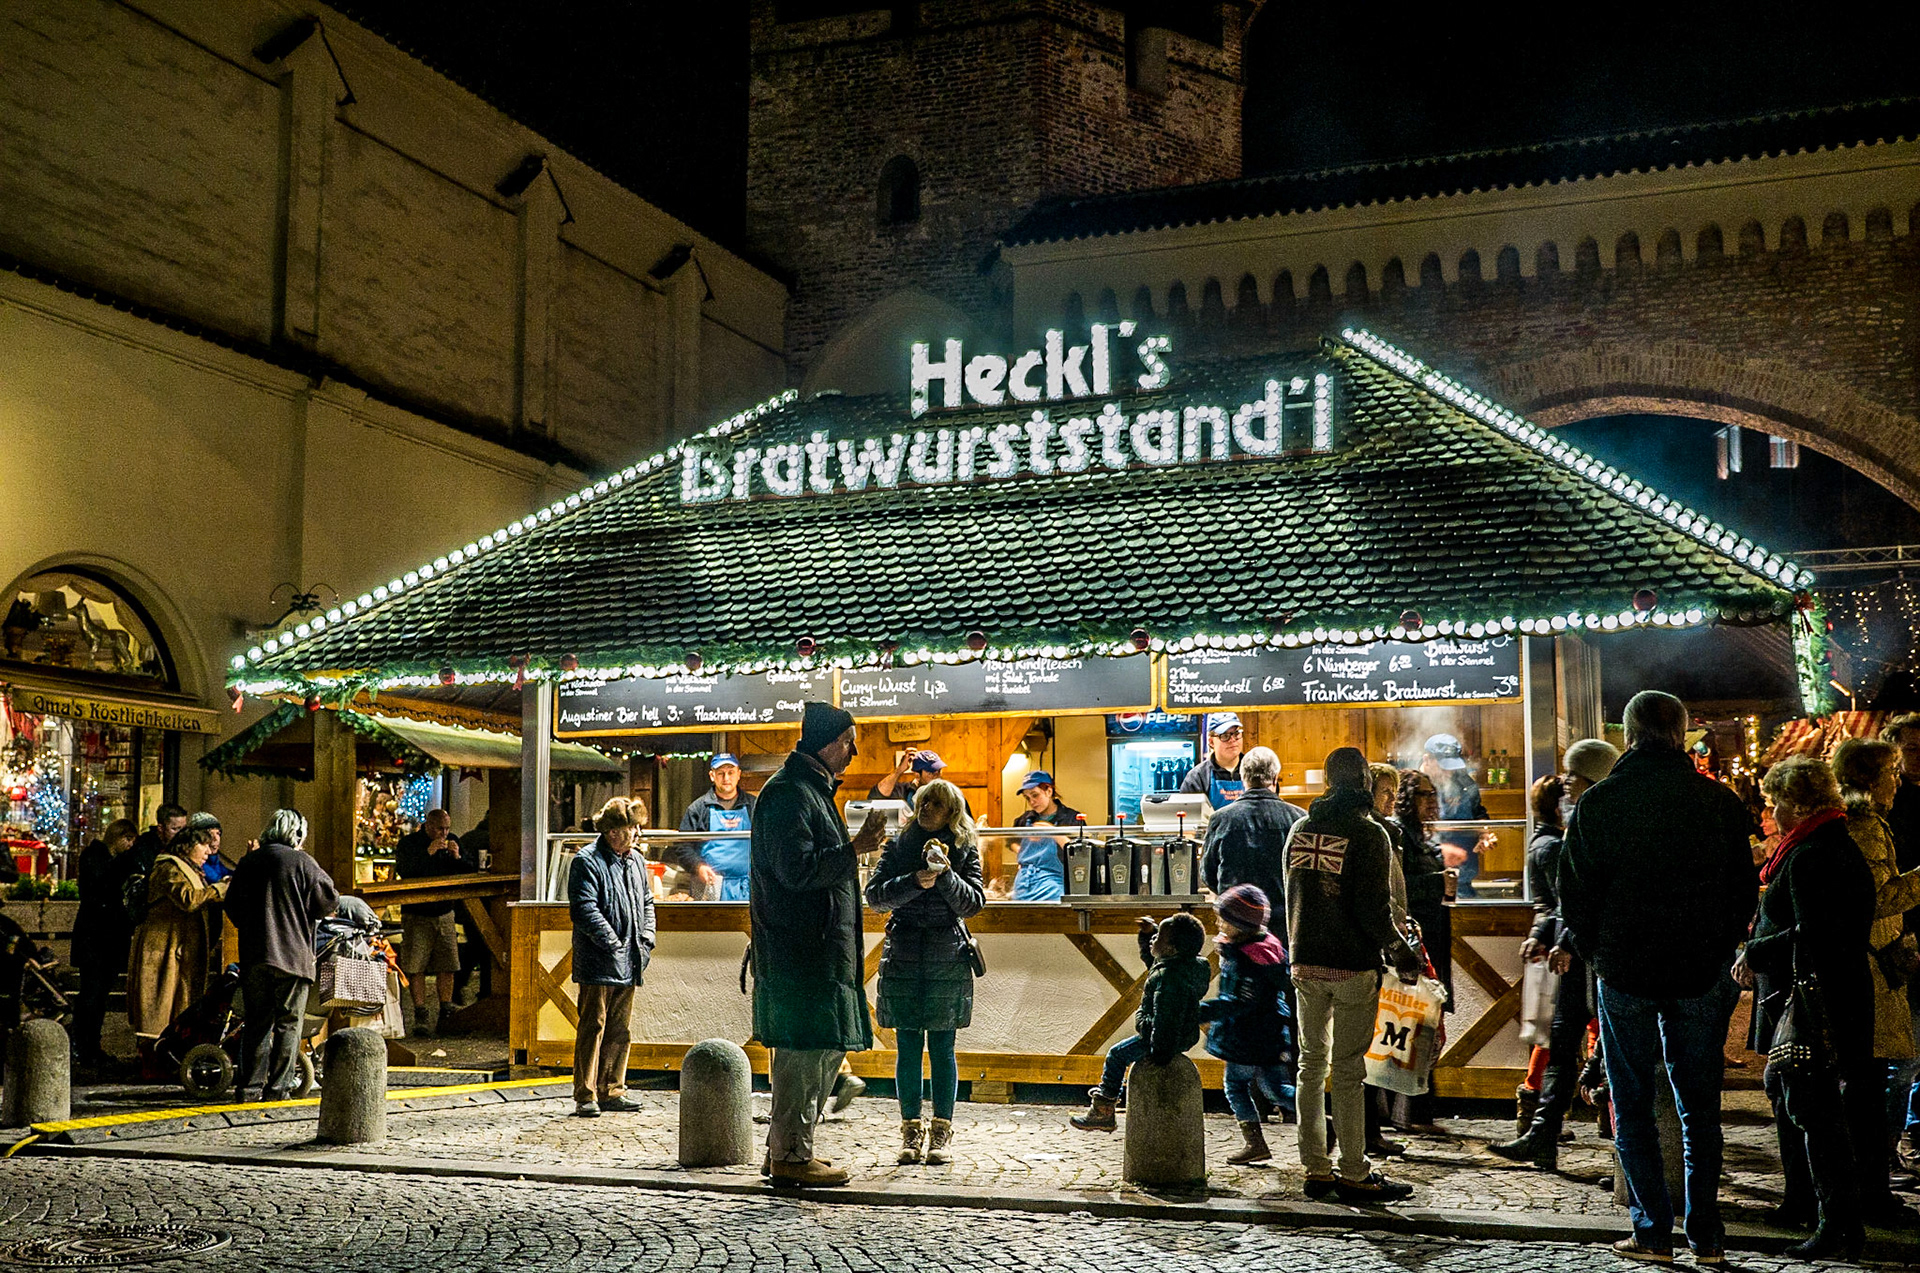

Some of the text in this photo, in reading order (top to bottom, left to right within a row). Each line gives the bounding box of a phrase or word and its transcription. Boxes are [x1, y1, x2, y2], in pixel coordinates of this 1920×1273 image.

[909, 320, 1173, 419] Heckl's
[679, 373, 1335, 504] Bratwurststand'l
[1312, 645, 1322, 655] in
[1322, 644, 1335, 654] der
[1423, 639, 1489, 658] Bratwurst
[1303, 656, 1313, 674] 6
[1429, 655, 1496, 667] in der Semmel
[985, 672, 1000, 683] mit
[1174, 693, 1222, 704] mit Kraut
[1382, 679, 1456, 702] Bratwurst
[843, 695, 899, 708] mit Semmel
[33, 695, 201, 730] Oma's Köstlichkeiten
[560, 707, 614, 728] Augustiner
[616, 706, 638, 724] Bier
[641, 704, 660, 721] hell
[693, 704, 757, 723] Flaschenpfand
[1145, 711, 1192, 724] PEPSI
[1380, 986, 1429, 1012] Müller
[1380, 1021, 1411, 1051] M
